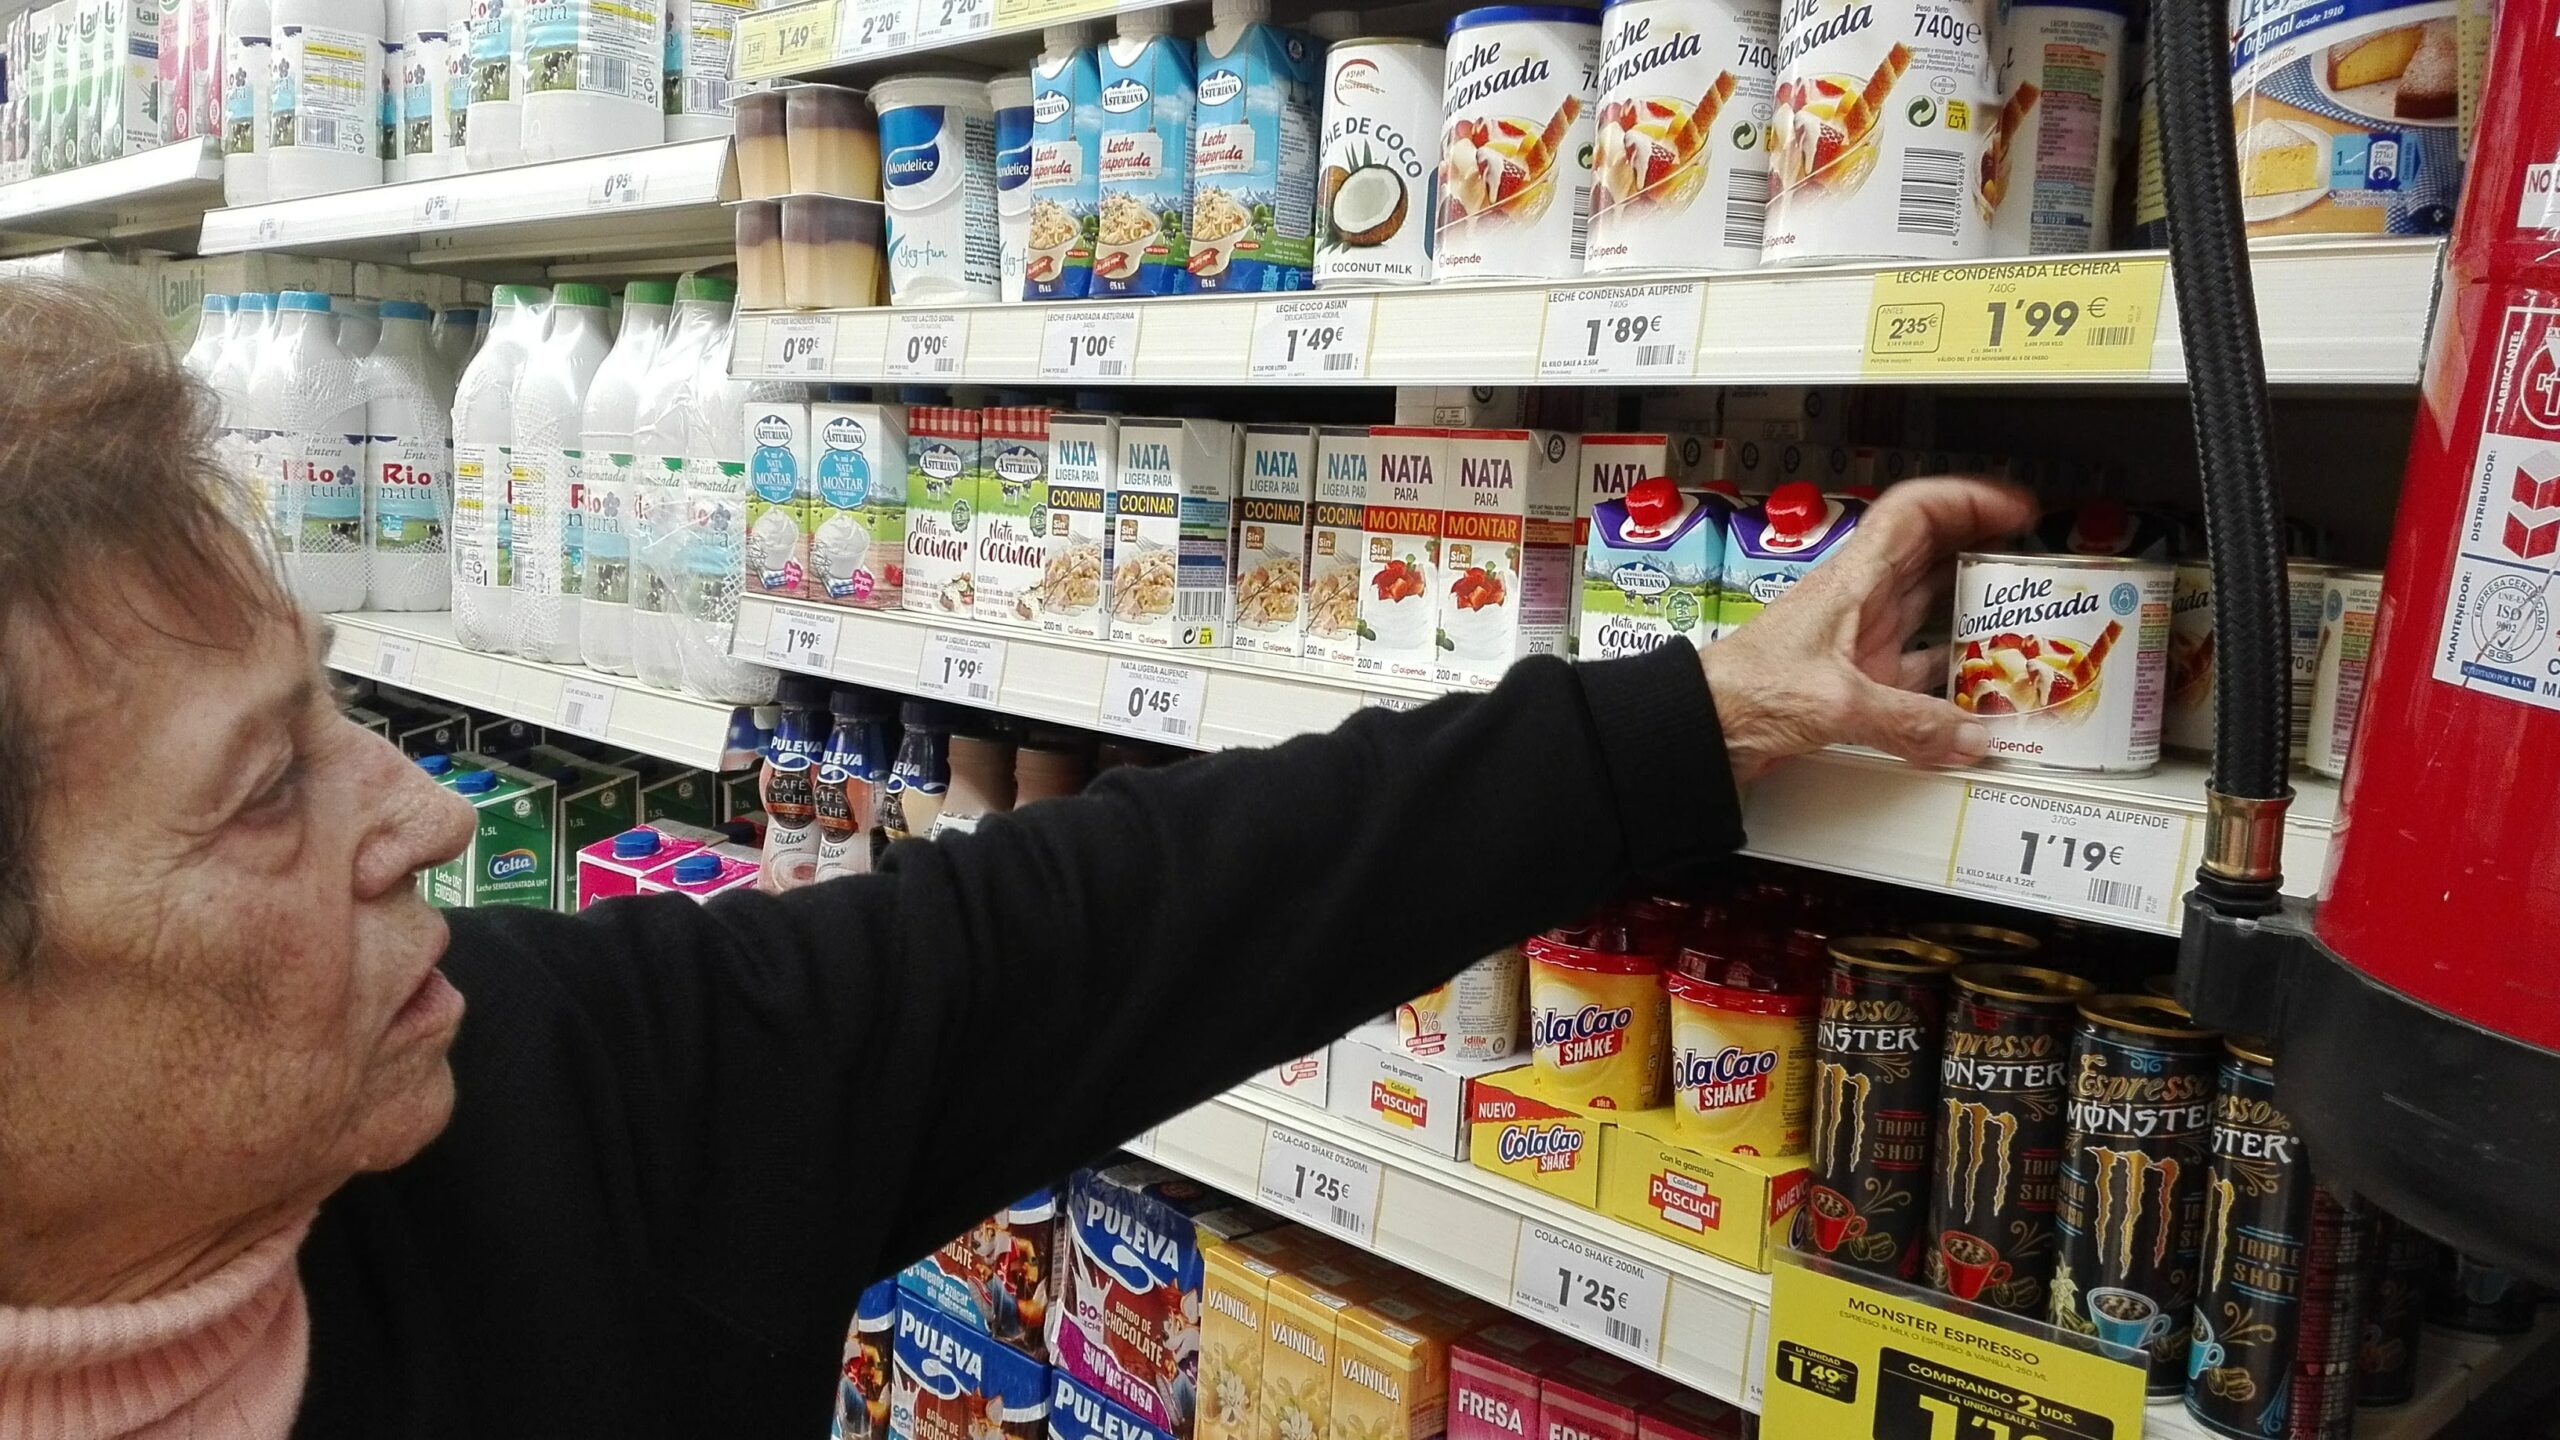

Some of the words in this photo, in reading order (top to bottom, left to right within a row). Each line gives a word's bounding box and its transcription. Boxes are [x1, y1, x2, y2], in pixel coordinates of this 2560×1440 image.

[2244, 17, 2295, 56] Original
[2295, 15, 2322, 29] desde
[2322, 5, 2345, 21] 1910
[1106, 137, 1135, 154] Leche
[1201, 131, 1228, 148] Leche
[1346, 116, 1372, 136] DE
[1375, 124, 1424, 178] COCO
[887, 158, 934, 176] Mondelice
[1331, 262, 1381, 274] COCONUT
[1384, 263, 1413, 275] MILK
[1896, 269, 1940, 284] LECHE
[1942, 265, 2049, 282] CONDENSADA
[2051, 262, 2122, 278] LECHERA
[1548, 293, 1576, 303] LECHE
[1578, 287, 1646, 301] CONDENSADA
[1648, 284, 1694, 296] ALIPENDE
[1987, 282, 2017, 295] 740G
[1047, 312, 1065, 322] LECHE
[1276, 302, 1298, 314] LECHE
[1300, 301, 1323, 313] COCO
[1324, 300, 1348, 311] ASIAN
[1986, 296, 2110, 348] 1'99€
[1286, 326, 1345, 363] 1'49€
[1586, 315, 1663, 357] 1'89€
[782, 336, 821, 364] 0'89€
[907, 334, 948, 364] 0'90€
[1069, 335, 1116, 366] 1'00€
[825, 430, 864, 444] ASTURIANA
[1058, 439, 1098, 468] NATA
[1128, 443, 1171, 472] NATA
[1254, 449, 1299, 479] NATA
[382, 462, 432, 485] Rio
[756, 472, 792, 486] MONTAR
[922, 459, 961, 474] ASTURIANA
[998, 459, 1040, 475] ASTURIANA
[1055, 467, 1080, 482] LIGERA
[1081, 470, 1099, 484] PARA
[1327, 452, 1368, 483] NATA
[1380, 453, 1434, 485] NATA
[1460, 457, 1514, 490] NATA
[822, 477, 864, 491] MONTAR
[1124, 471, 1151, 486] LIGERA
[1152, 473, 1173, 488] PARA
[1249, 479, 1280, 494] LIGERA
[1281, 480, 1300, 495] PARA
[1321, 481, 1350, 497] LIGERA
[1051, 489, 1102, 511] COCINAR
[1119, 494, 1175, 515] COCINAR
[1393, 486, 1419, 502] PARA
[1473, 491, 1500, 508] PARA
[2470, 449, 2498, 543] DISTRIBUIDOR:
[1244, 500, 1301, 522] COCINAR
[1368, 509, 1438, 534] MONTAR
[1052, 518, 1067, 531] Sin
[1121, 524, 1135, 537] Sin
[1246, 530, 1261, 542] Sin
[1447, 516, 1518, 540] MONTAR
[907, 533, 968, 564] Cocinar
[979, 534, 1046, 569] Cocinar
[1616, 574, 1668, 590] ASTURIANA
[1983, 576, 2054, 608] Leche
[2474, 578, 2507, 618] EMPRESA
[1636, 621, 1658, 633] para
[1957, 591, 2100, 639] Condensada
[2446, 571, 2473, 663] MANTENEDOR:
[1159, 667, 1189, 679] ALIPENDE
[1358, 657, 1373, 670] 200
[1128, 686, 1181, 718] 0'45€
[770, 737, 822, 754] PULEVA
[1968, 786, 2007, 804] LECHE
[2009, 793, 2102, 820] CONDENSADA
[2107, 809, 2170, 830] ALIPENDE
[2051, 814, 2078, 828] 370G
[493, 856, 532, 876] Celta
[2020, 830, 2125, 877] 1'19€
[1956, 866, 1965, 875] EL
[1966, 868, 1984, 879] KILO
[1985, 872, 2005, 883] SALE
[1564, 1033, 1616, 1062] SHAKE
[1373, 1085, 1424, 1120] Pascual
[1703, 1078, 1758, 1108] SHAKE
[1478, 1101, 1517, 1119] NUEVO
[1875, 1117, 1927, 1138] TRIPLE
[1271, 1129, 1311, 1152] COLA-CAO
[1311, 1143, 1334, 1161] SHAKE
[1873, 1142, 1926, 1162] SHOT
[1539, 1150, 1572, 1172] SHAKE
[1659, 1151, 1675, 1165] Con
[1294, 1164, 1351, 1202] 1'25€
[1671, 1175, 1699, 1192] Calidad
[1651, 1179, 1716, 1220] Pascual
[1086, 1198, 1180, 1272] PULEVA
[1534, 1228, 1583, 1255] COLA-CAO
[1584, 1247, 1614, 1267] SHAKE
[1615, 1259, 1645, 1280] 200ML
[2237, 1236, 2300, 1262] TRIPLE
[1558, 1267, 1630, 1313] 1'25€
[2232, 1268, 2298, 1293] SHOT
[1207, 1287, 1258, 1332] VAINILLA
[1531, 1296, 1543, 1307] POR
[1115, 1300, 1140, 1326] BATIDO
[1141, 1318, 1152, 1336] DE
[1839, 1309, 1881, 1329] ESPRESSO
[1104, 1309, 1164, 1368] CHOCOLATE
[1270, 1320, 1327, 1367] VAINILLA
[1847, 1296, 1939, 1335] MONSTER
[1943, 1326, 2041, 1366] ESPRESSO
[900, 1309, 983, 1382] PULEVA
[1794, 1346, 1807, 1354] LA
[1806, 1349, 1841, 1367] UNIDAD
[1340, 1356, 1401, 1404] VAINILLA
[1907, 1361, 2014, 1406] COMPRANDO
[2016, 1393, 2038, 1418] 2
[2039, 1404, 2078, 1427] UDS.
[1457, 1387, 1524, 1436] FRESA
[1947, 1393, 1961, 1403] LA
[1962, 1397, 2003, 1418] UNIDAD
[2003, 1409, 2028, 1426] SALE
[2028, 1418, 2041, 1430] A:
